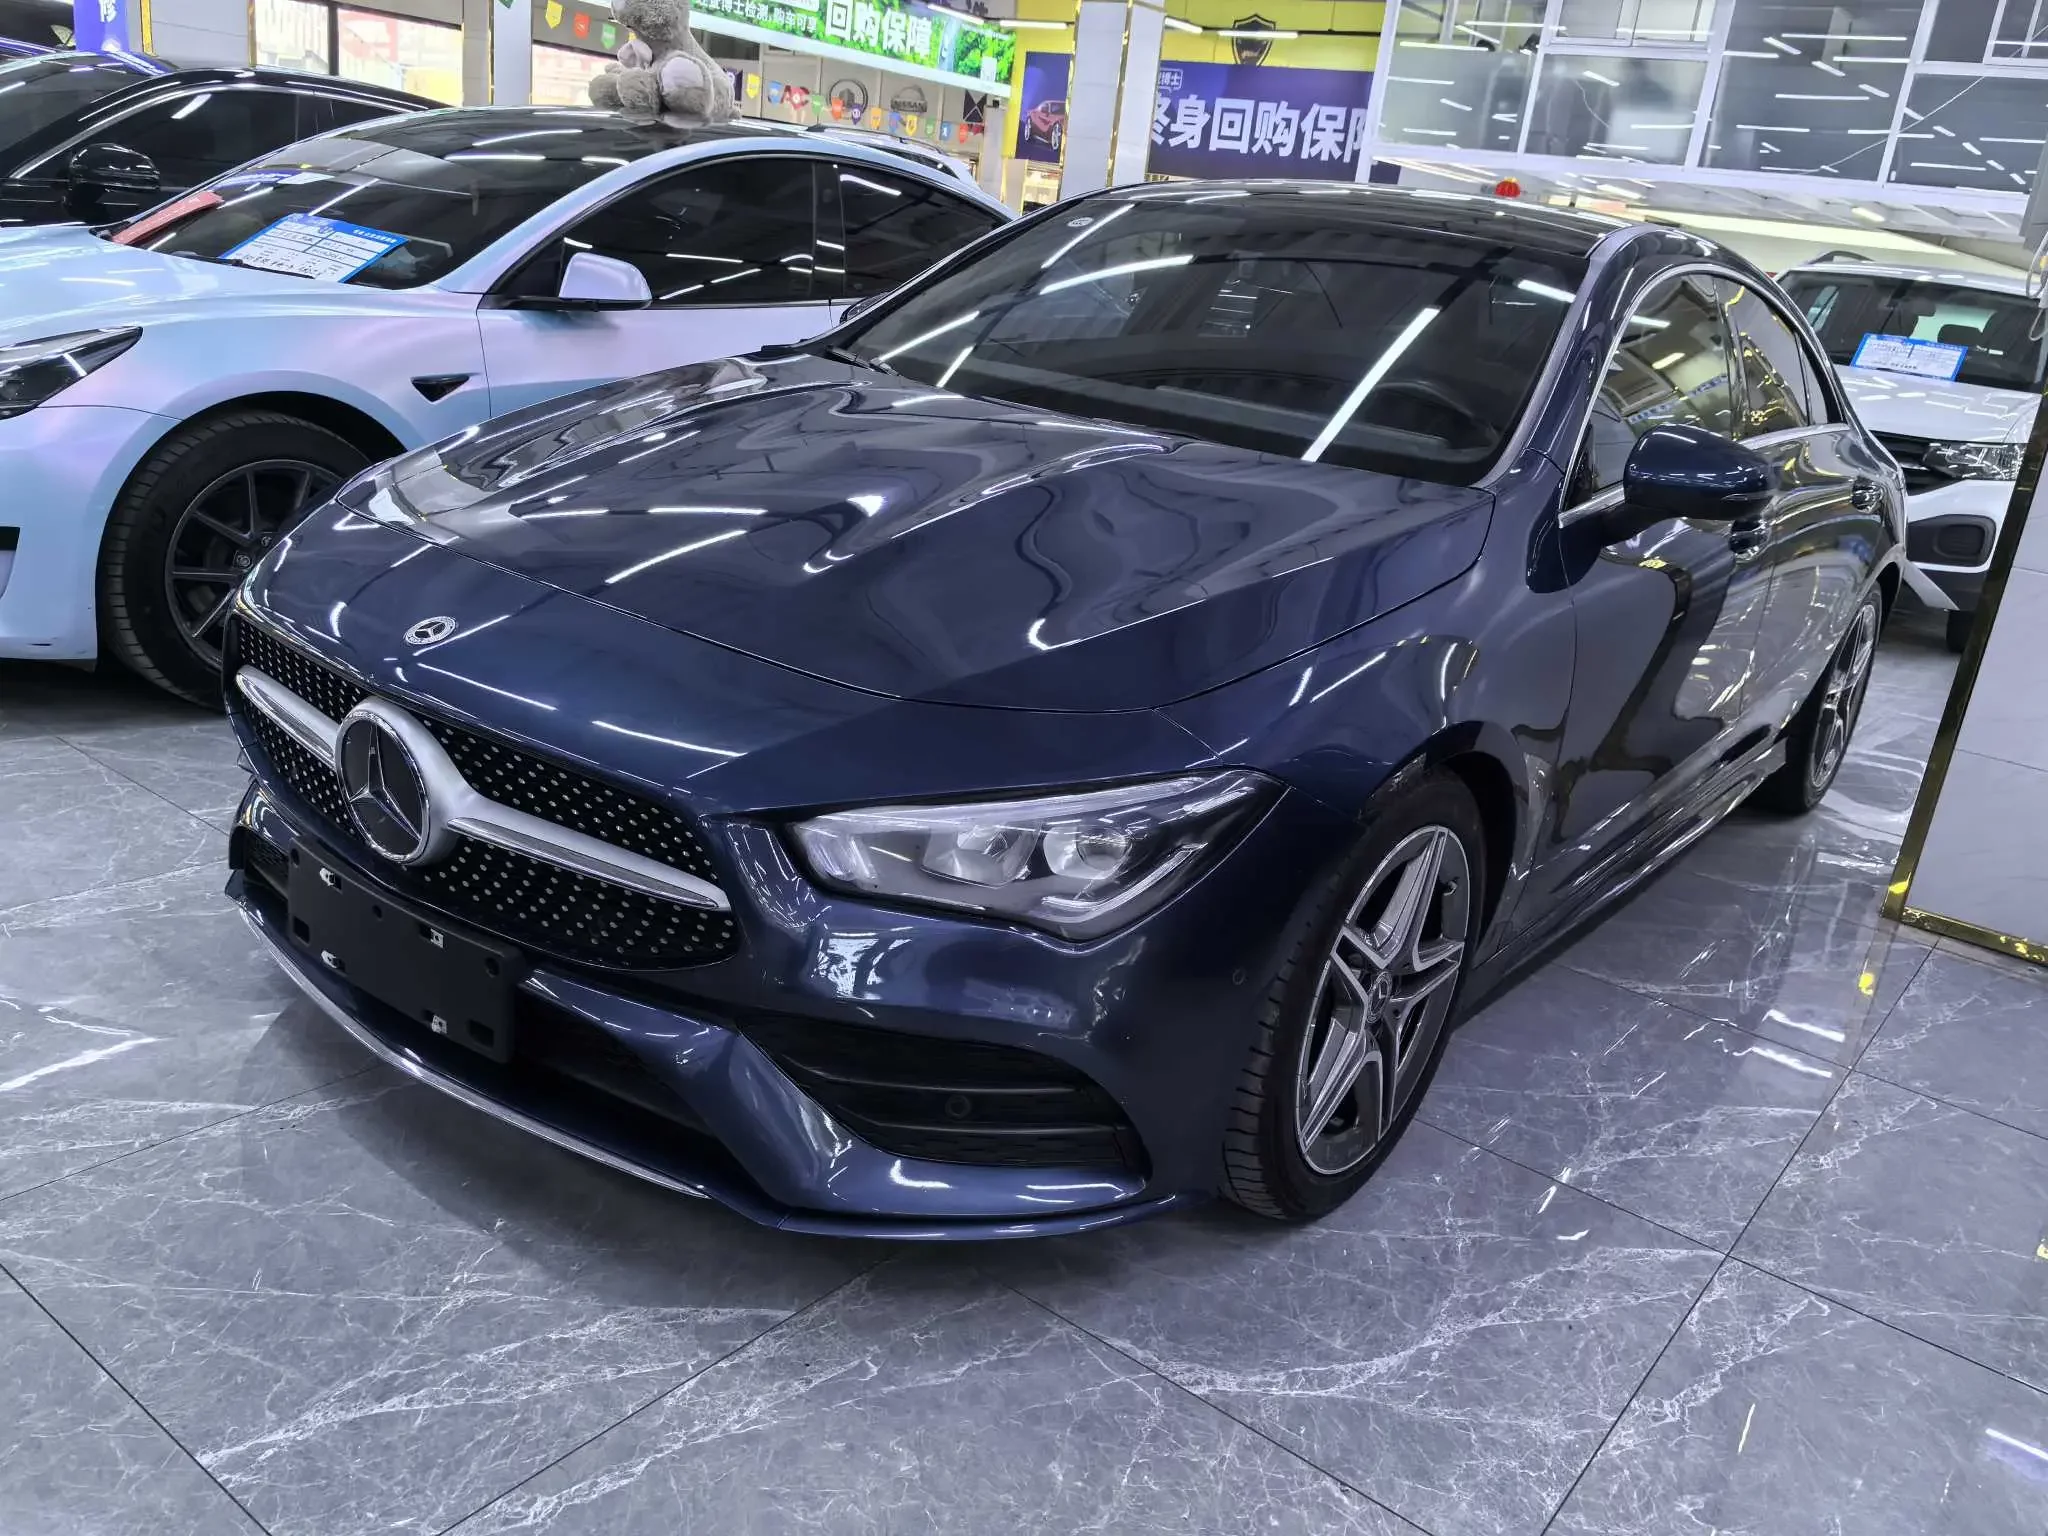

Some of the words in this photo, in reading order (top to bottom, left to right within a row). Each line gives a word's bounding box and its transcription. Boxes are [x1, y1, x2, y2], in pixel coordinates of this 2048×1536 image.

[825, 0, 932, 57] 回购保障
[1158, 71, 1181, 86] 博士
